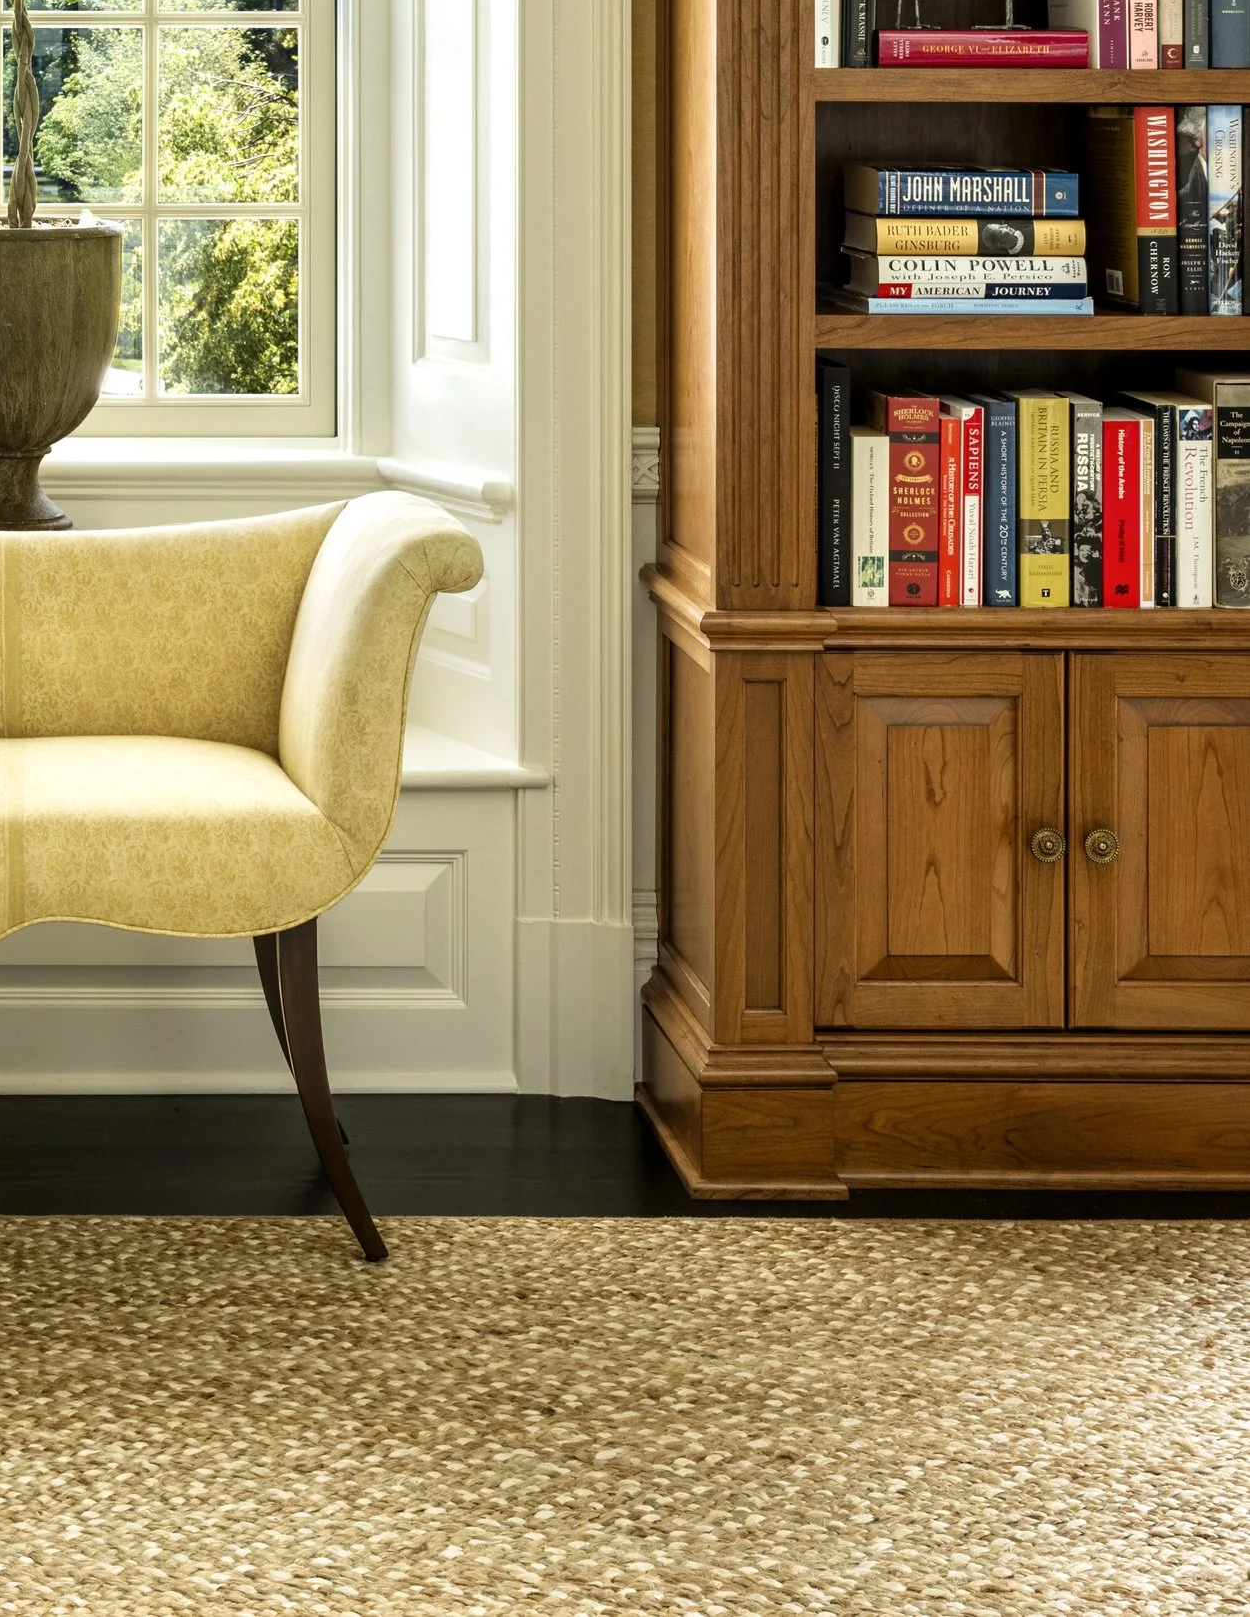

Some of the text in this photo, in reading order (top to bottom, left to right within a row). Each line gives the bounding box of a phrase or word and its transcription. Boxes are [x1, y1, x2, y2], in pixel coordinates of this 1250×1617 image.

[1134, 2, 1144, 32] HARVEY
[1143, 2, 1154, 32] ROBERT
[922, 45, 981, 54] GEORGE VI
[1147, 115, 1170, 220] WASHINGTON
[1214, 129, 1226, 179] CROSSING
[902, 176, 1030, 203] JOHN MARSHALL
[887, 224, 969, 237] RUTH BADER
[895, 240, 961, 252] GINSBURG
[888, 259, 1054, 272] COLIN POWELL
[891, 273, 921, 281] with
[927, 273, 977, 282] Joseph
[1149, 241, 1159, 295] CHERNOW
[1162, 257, 1171, 279] RON
[889, 286, 1051, 296] MY AMERICAN JOURNEY
[968, 427, 980, 491] SAPIENS
[1037, 406, 1049, 512] BRITAIN IN PERSIA
[1049, 425, 1060, 495] RUSSIA AND
[1077, 433, 1089, 492] RUSSIA
[1184, 447, 1198, 530] Revolution
[1199, 446, 1208, 503] The French
[892, 486, 936, 495] SHERLOCK
[897, 496, 931, 505] HOLMES
[969, 503, 977, 527] Yuval
[968, 553, 976, 581] Harari
